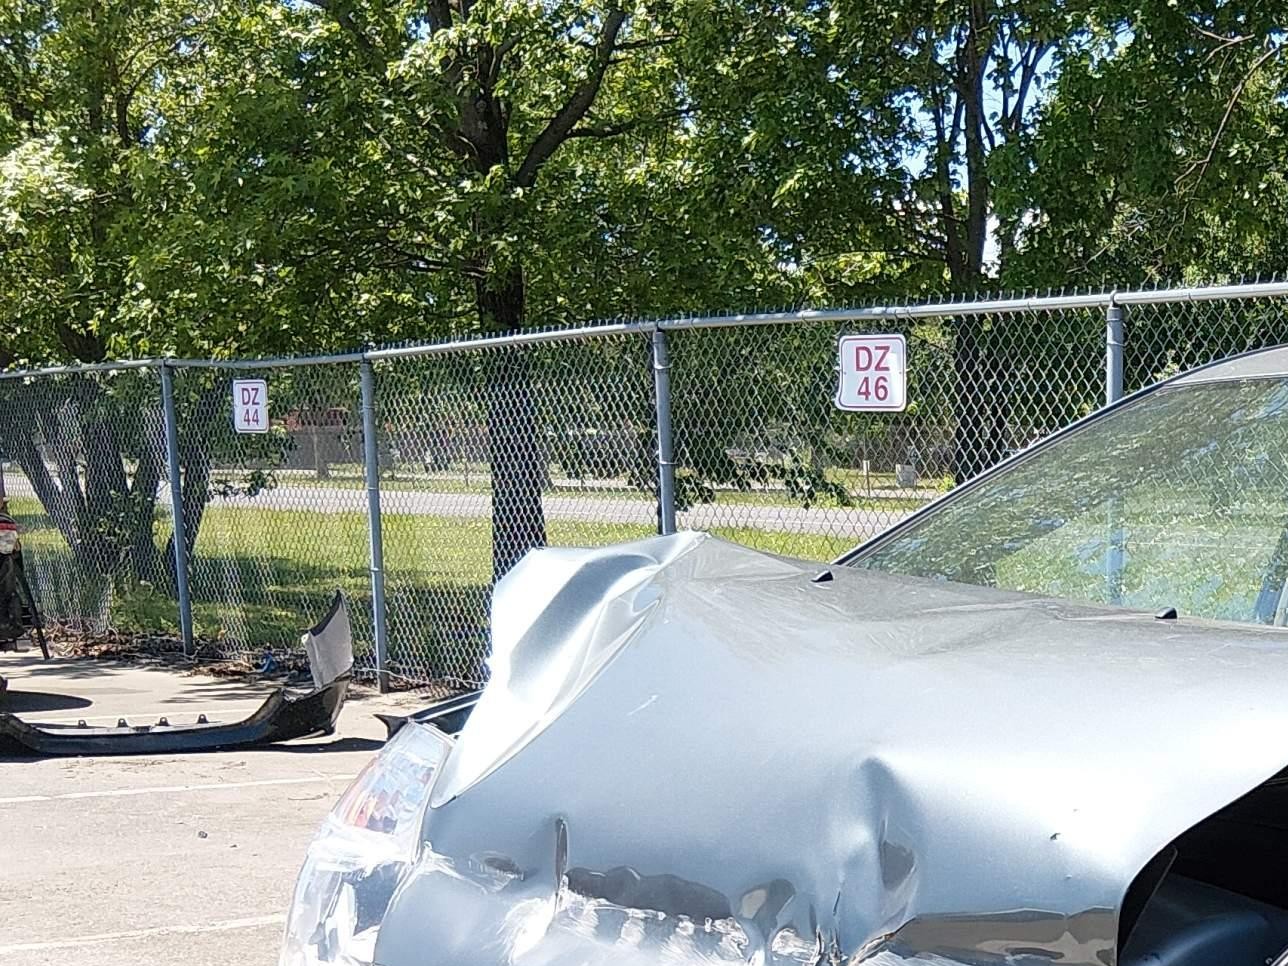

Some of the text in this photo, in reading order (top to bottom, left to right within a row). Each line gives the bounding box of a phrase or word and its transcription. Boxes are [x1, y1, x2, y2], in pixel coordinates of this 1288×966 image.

[855, 345, 891, 372] DZ
[241, 387, 260, 406] DZ
[857, 375, 889, 402] 46
[243, 408, 260, 426] 44
